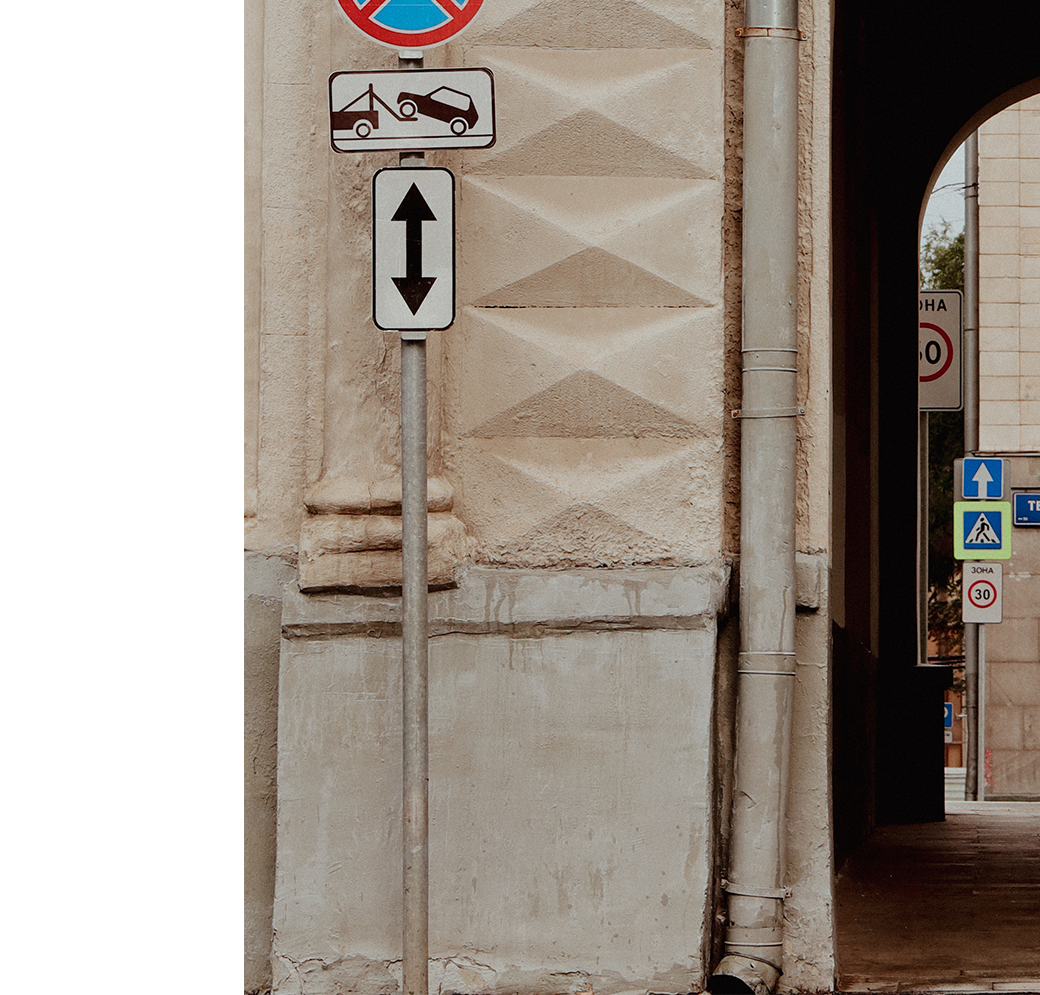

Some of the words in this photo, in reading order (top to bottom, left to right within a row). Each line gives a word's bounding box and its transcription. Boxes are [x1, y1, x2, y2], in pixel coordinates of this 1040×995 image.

[919, 298, 948, 312] НА
[919, 340, 942, 365] 0
[970, 566, 994, 574] ЗОНА
[974, 588, 991, 600] 30
